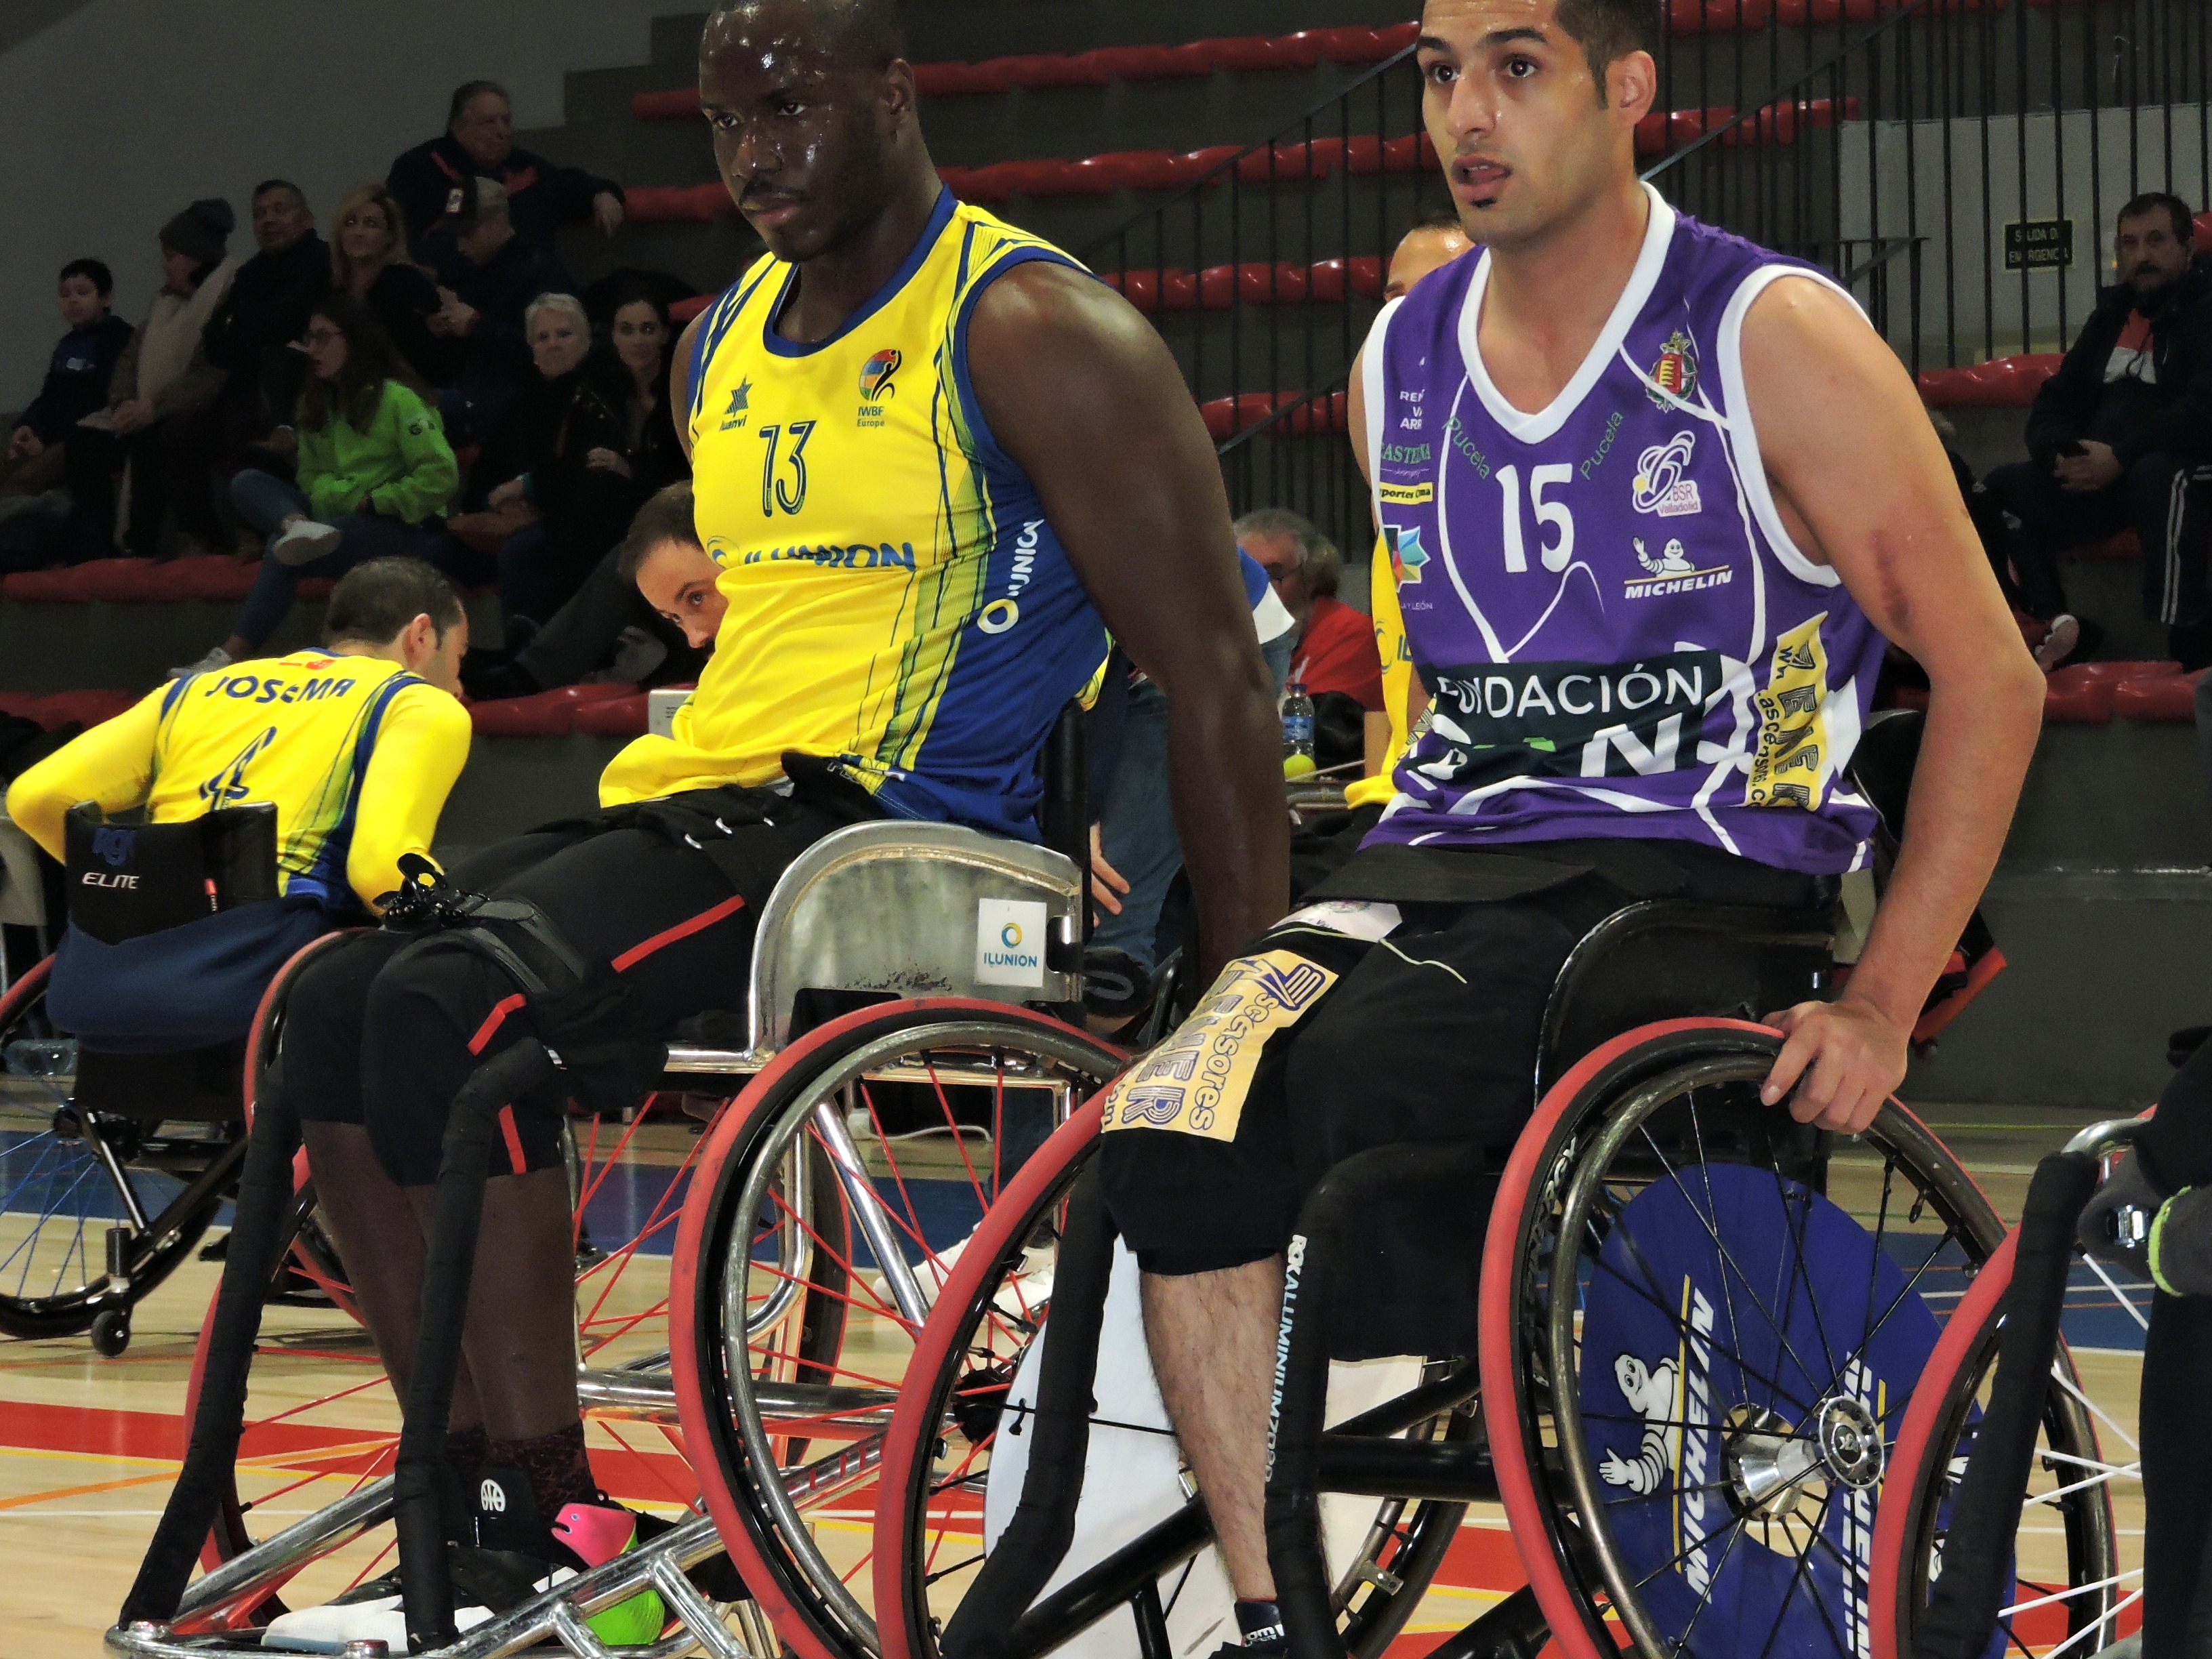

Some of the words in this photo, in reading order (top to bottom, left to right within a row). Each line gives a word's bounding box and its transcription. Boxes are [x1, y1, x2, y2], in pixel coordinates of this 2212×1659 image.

[858, 406, 885, 416] IWBF
[857, 419, 885, 428] Europe
[1441, 415, 1491, 480] Pucela
[1580, 411, 1624, 480] Pucela
[759, 420, 817, 517] 13
[1673, 483, 1694, 502] BSR
[1496, 463, 1573, 573] 15
[1660, 501, 1698, 514] Valladolid
[1624, 570, 1733, 599] MICHELIN
[82, 872, 140, 889] ELITE
[984, 952, 1038, 967] ILUNION
[1683, 1287, 1715, 1605] MICHELIN
